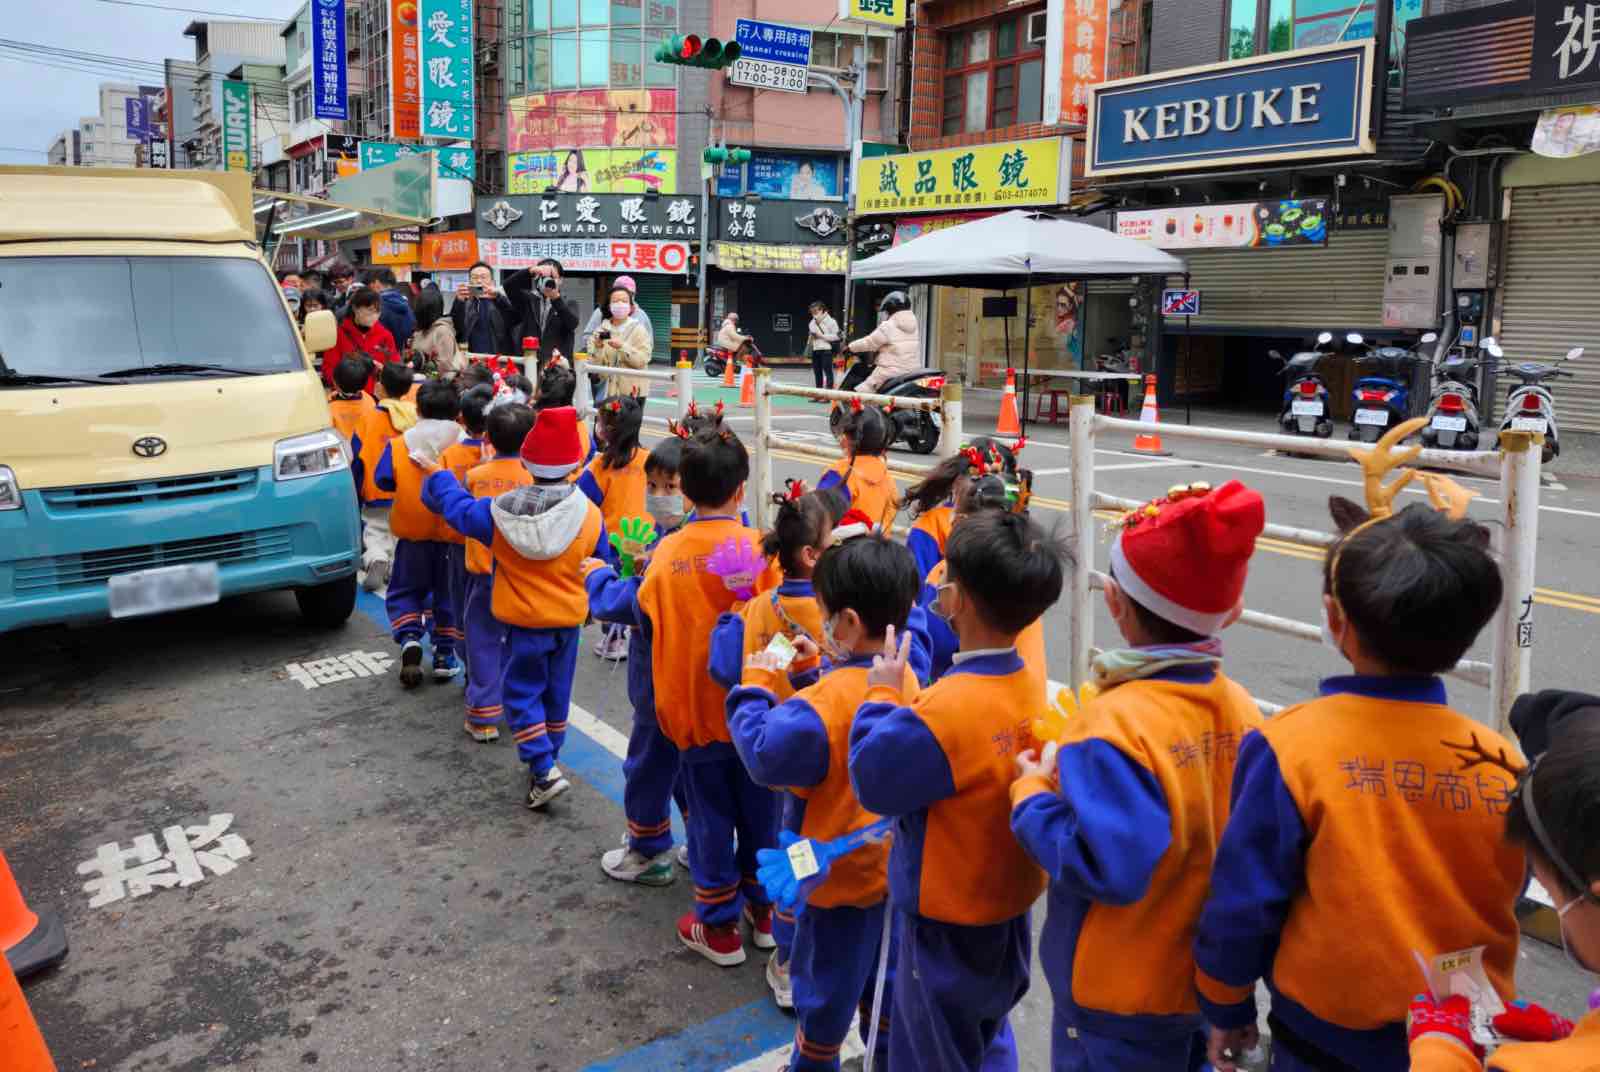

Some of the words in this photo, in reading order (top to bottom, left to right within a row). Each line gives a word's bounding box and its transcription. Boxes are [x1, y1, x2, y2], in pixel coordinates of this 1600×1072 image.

[737, 23, 810, 48] 行人專用時相
[736, 61, 804, 79] 07:00-08:00
[737, 71, 803, 89] 17:00-21:00
[1122, 82, 1322, 144] KEBUKE
[879, 148, 1029, 197] 誠品眼鏡
[539, 196, 697, 225] 仁愛眼鏡
[728, 202, 757, 219] 中原
[539, 223, 608, 233] HOWARD
[621, 225, 696, 235] EYEWEAR
[728, 221, 756, 238] 分店
